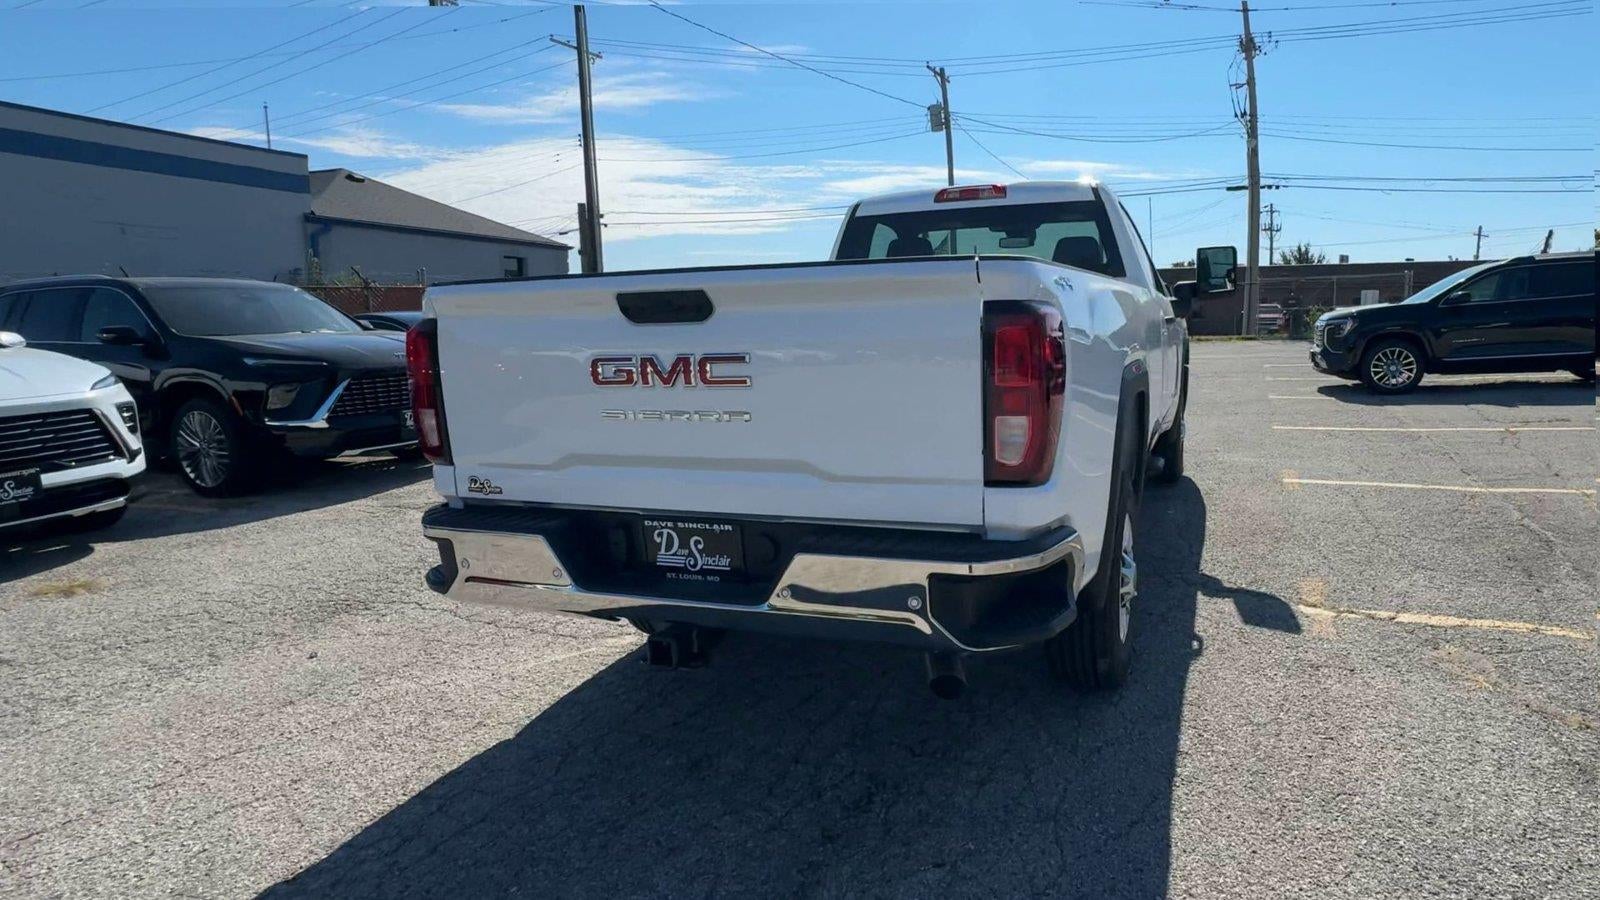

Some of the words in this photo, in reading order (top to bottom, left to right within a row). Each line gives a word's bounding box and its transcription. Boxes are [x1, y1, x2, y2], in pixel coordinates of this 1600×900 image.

[590, 353, 752, 389] GMC
[600, 408, 752, 423] SIERRA
[644, 520, 674, 528] DAVE
[677, 522, 733, 532] SINCLAIR
[653, 529, 689, 555] Dave
[685, 535, 731, 572] Sinclair
[706, 575, 720, 583] MO
